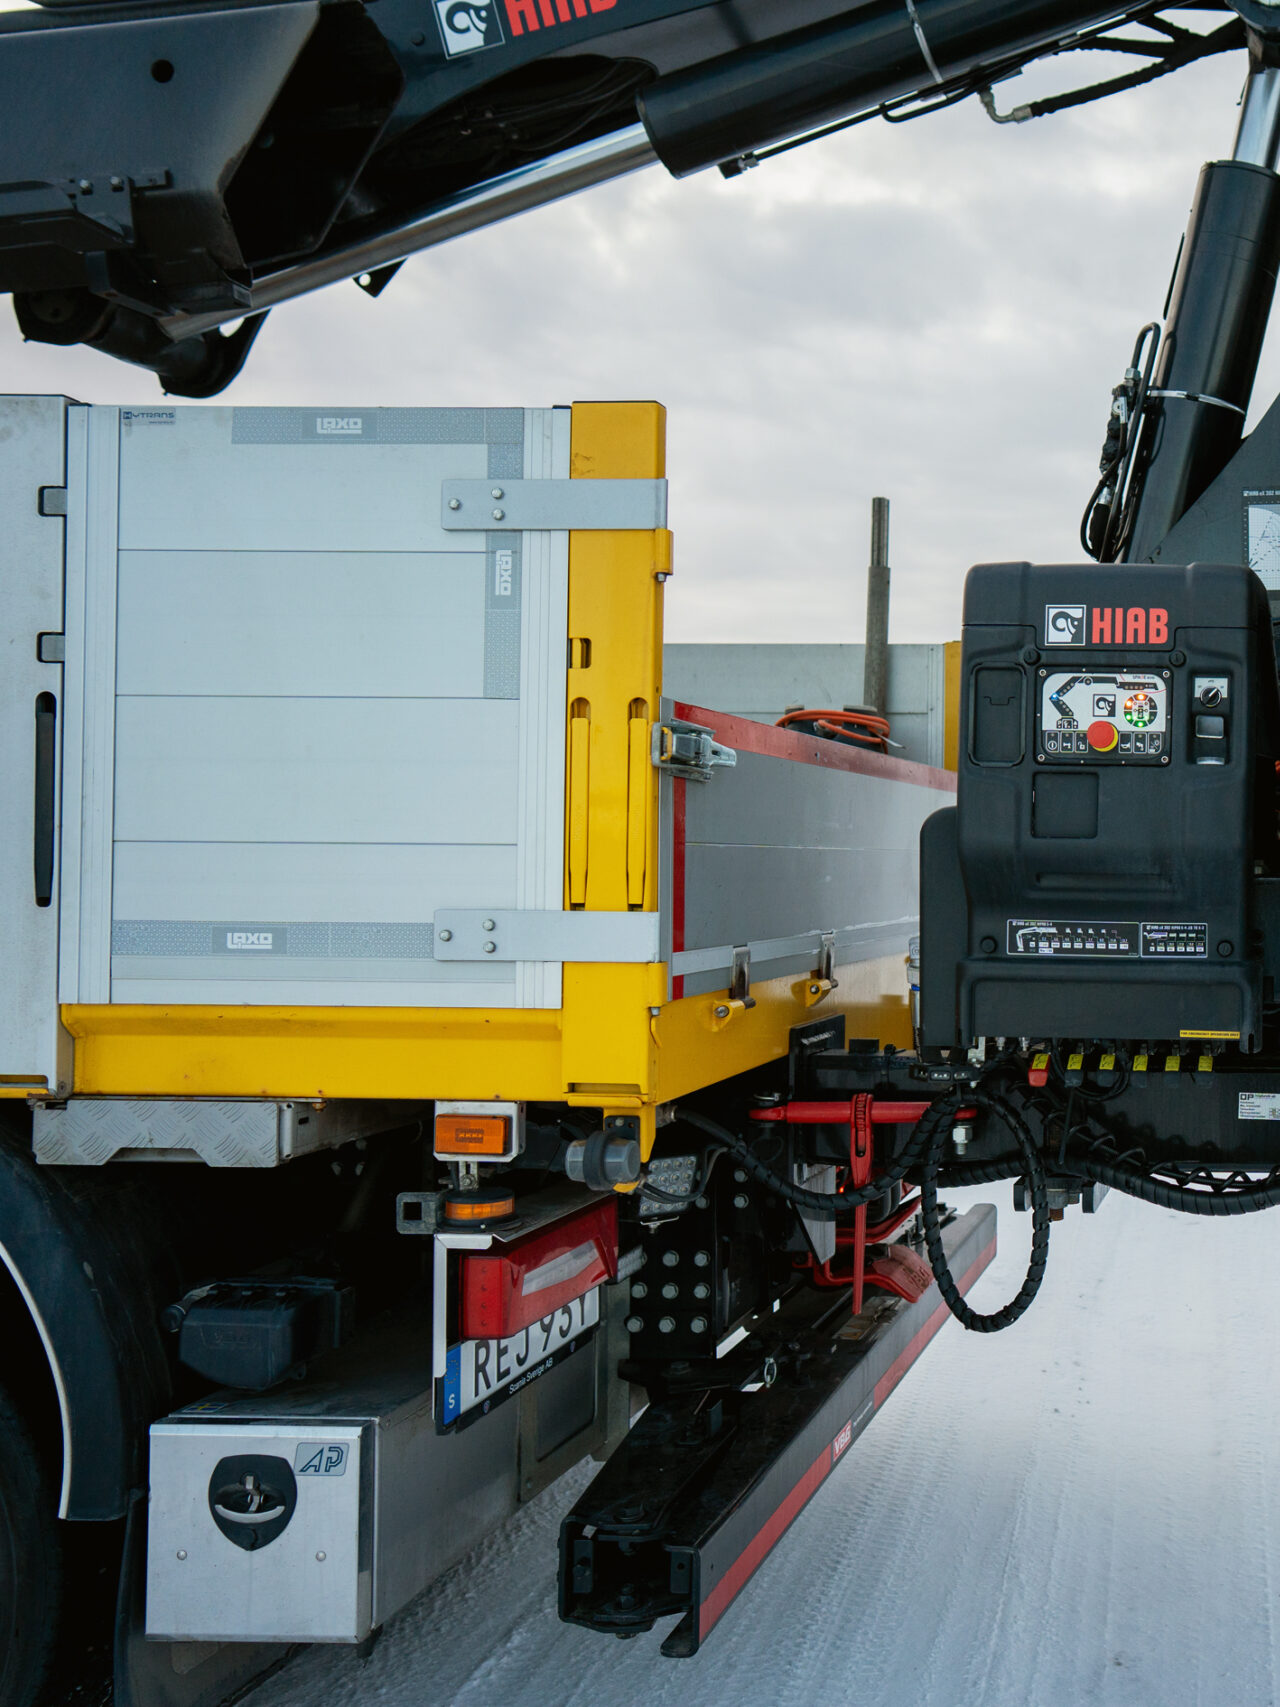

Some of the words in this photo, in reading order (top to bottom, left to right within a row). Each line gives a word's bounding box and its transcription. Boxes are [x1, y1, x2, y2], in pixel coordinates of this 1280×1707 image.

[316, 418, 362, 434] LAXO
[495, 549, 512, 596] LAXO
[1092, 607, 1168, 644] HIAB
[226, 932, 273, 950] LAXO
[474, 1326, 529, 1398] REJ
[509, 1376, 526, 1394] Scania
[526, 1364, 545, 1383] Sverige
[545, 1357, 553, 1369] AB
[448, 1393, 456, 1409] S
[299, 1446, 344, 1473] AP
